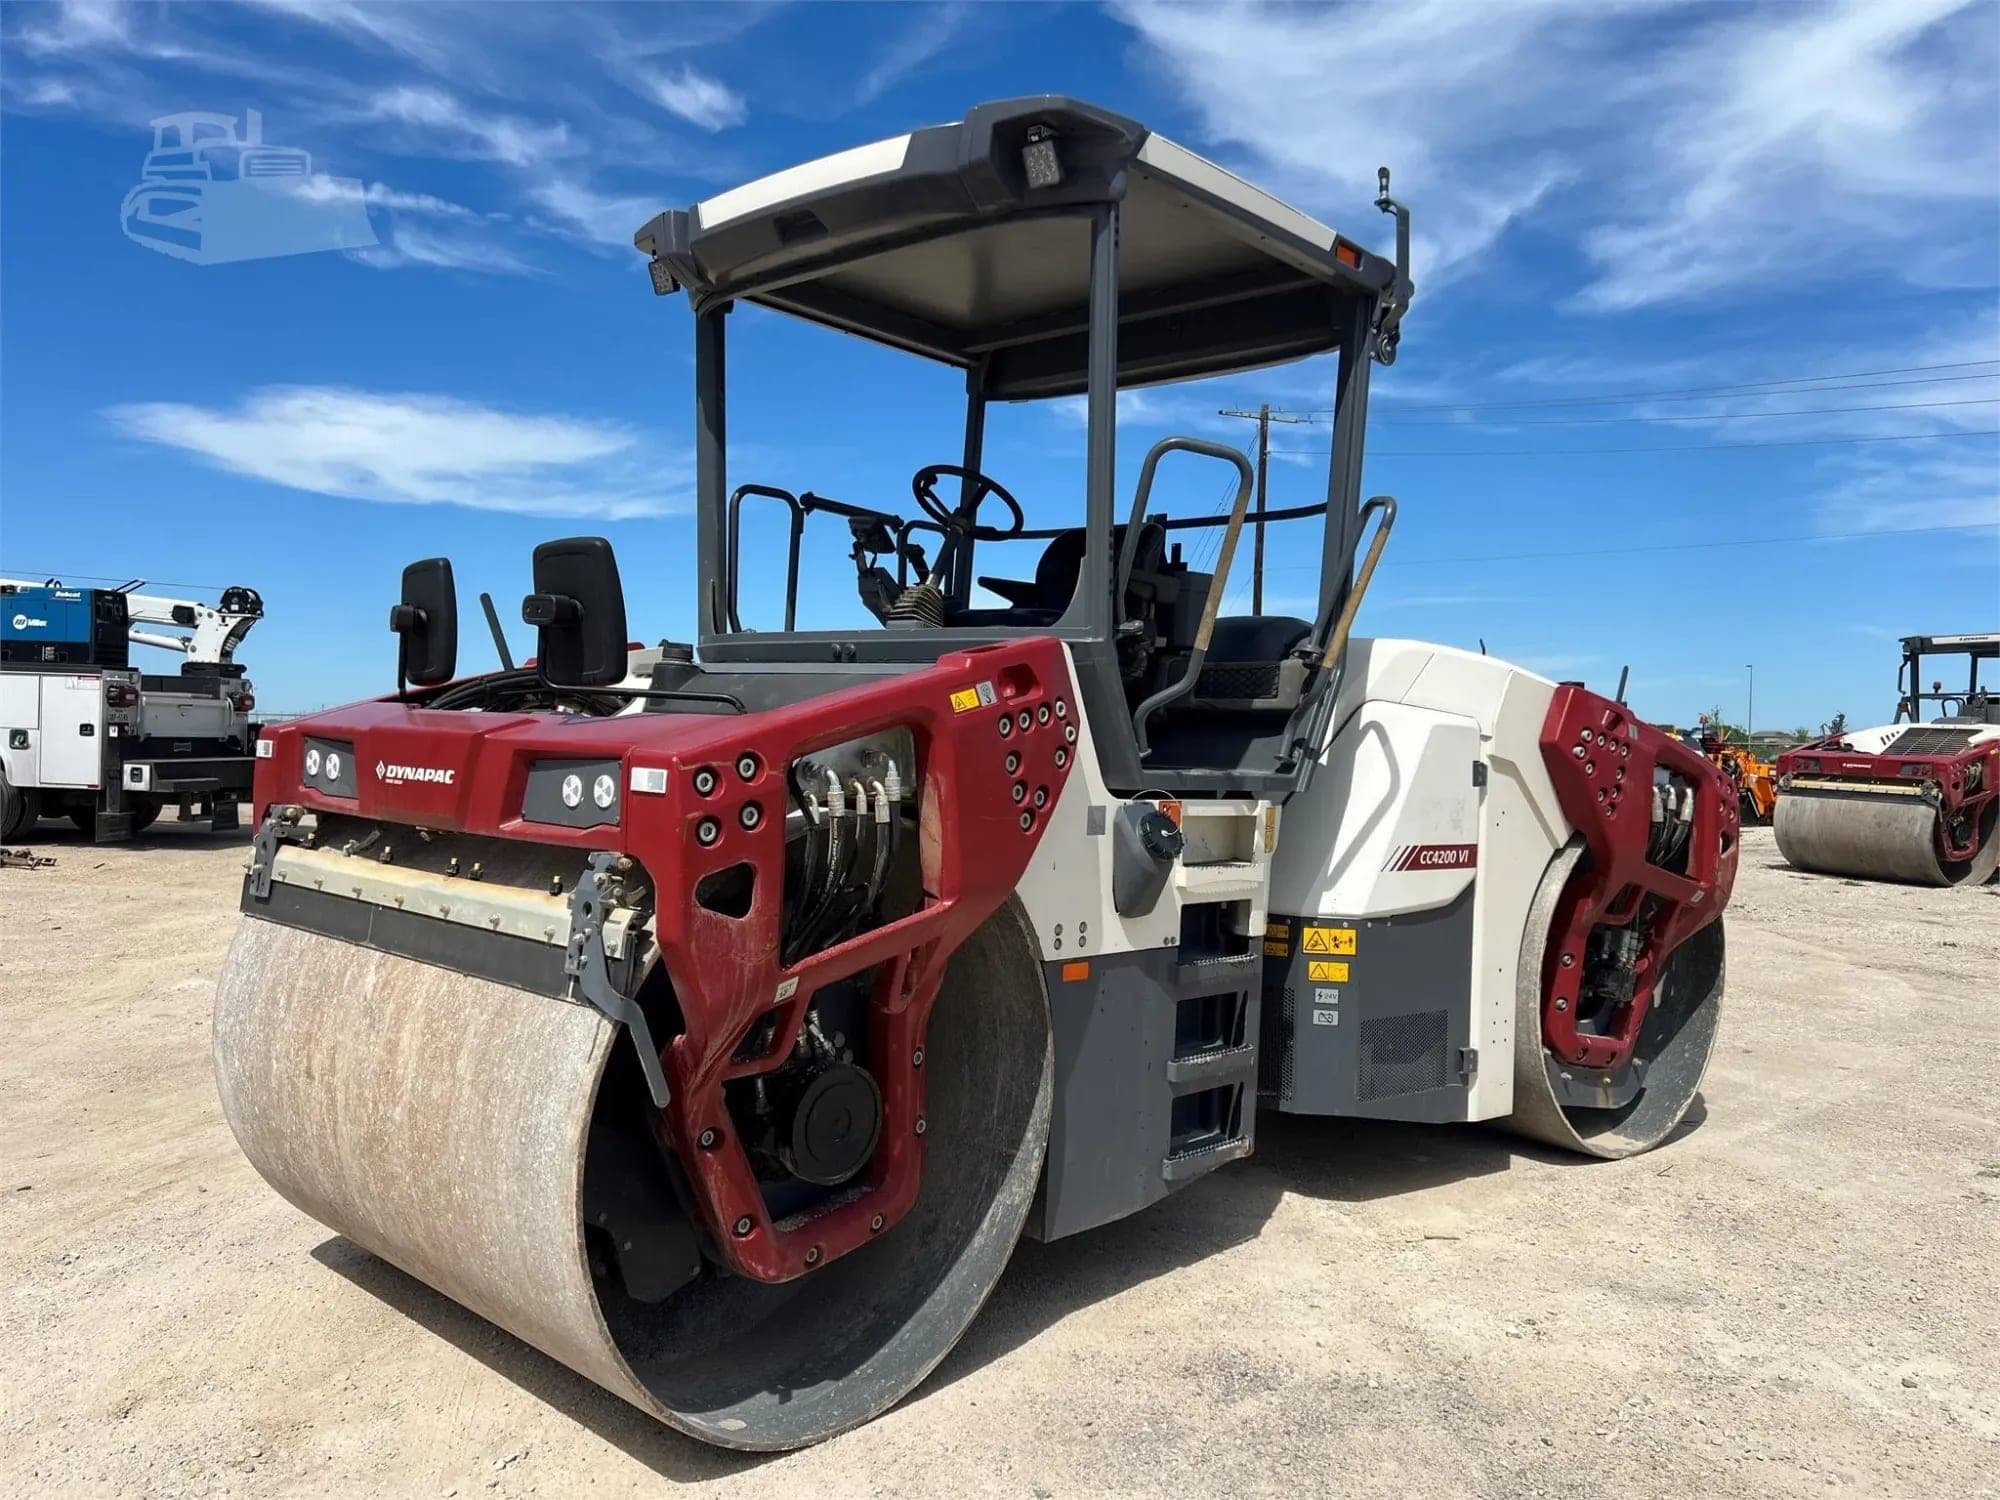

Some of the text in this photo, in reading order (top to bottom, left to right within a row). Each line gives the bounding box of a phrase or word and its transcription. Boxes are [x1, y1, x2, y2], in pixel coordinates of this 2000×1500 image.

[386, 764, 455, 785] DYNAPAC
[1420, 849, 1469, 865] CC4200 VI
[1324, 992, 1338, 1000] 24V
